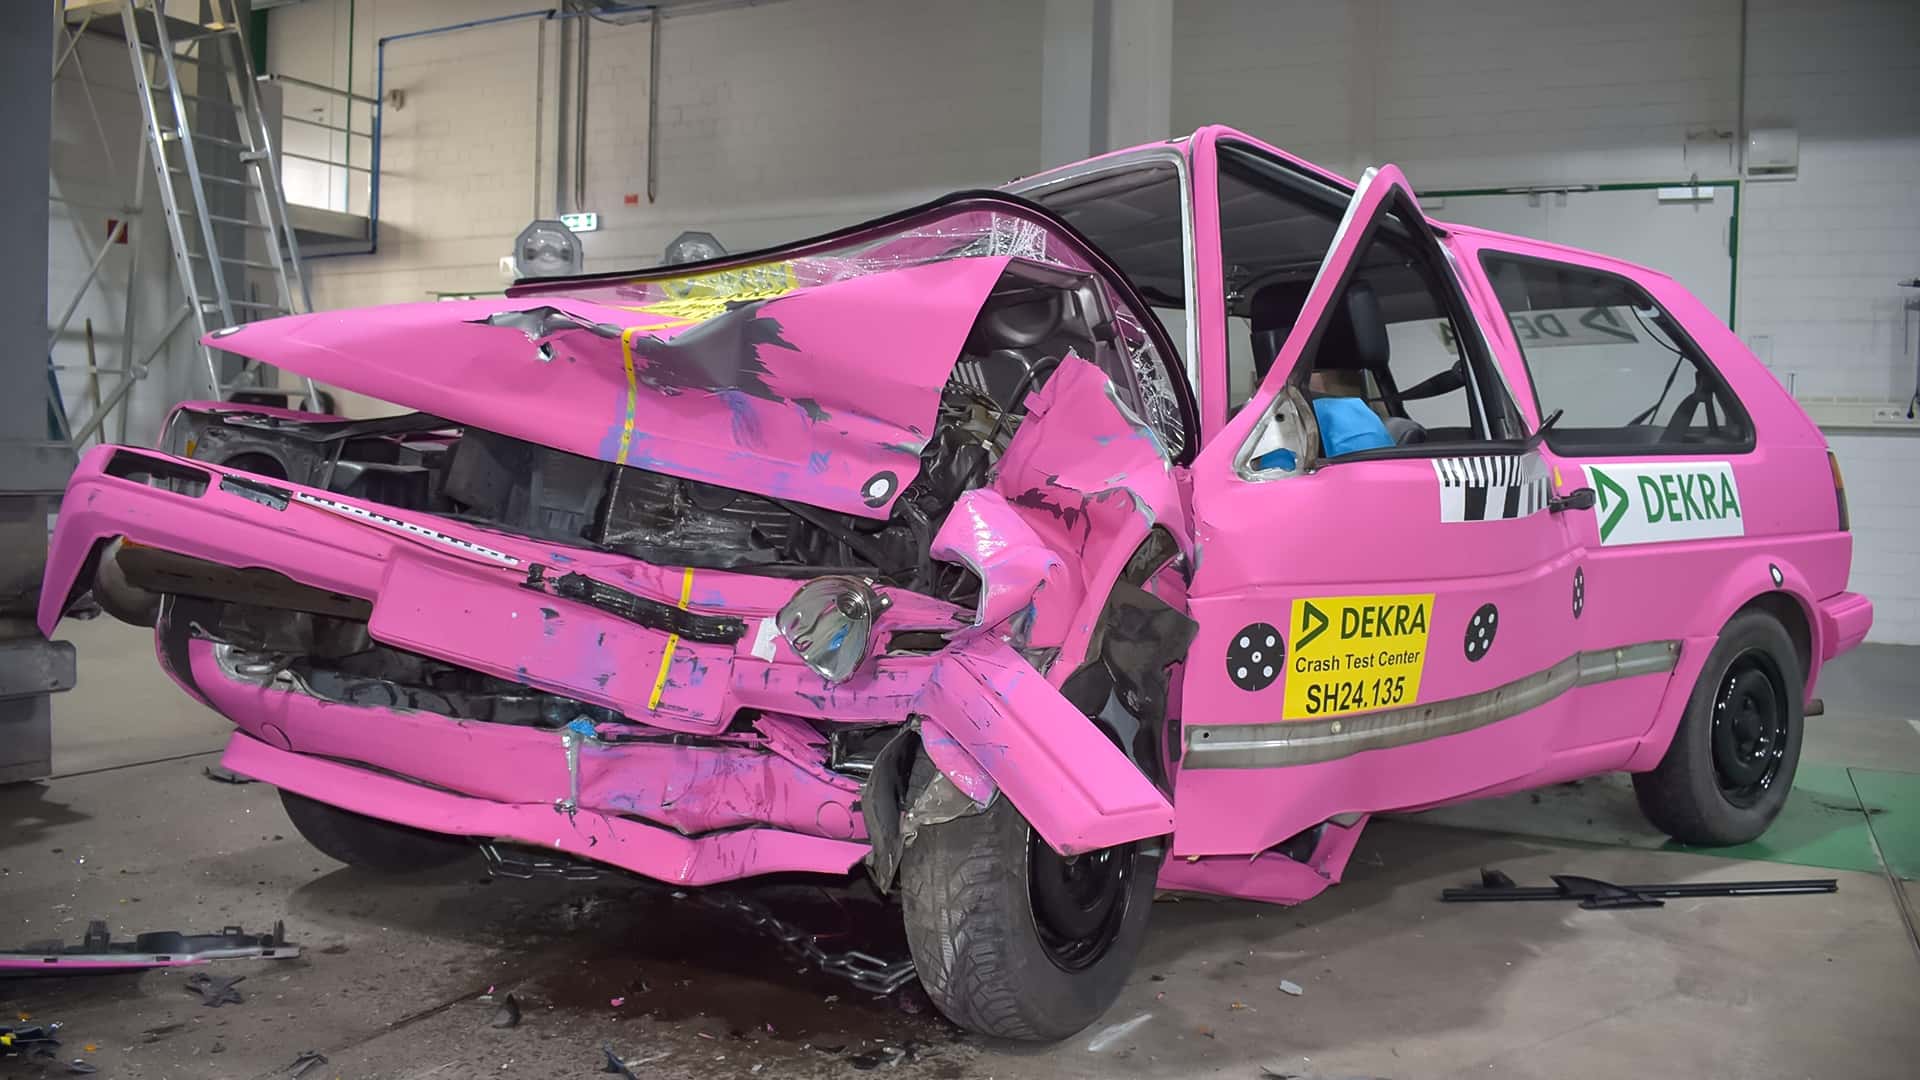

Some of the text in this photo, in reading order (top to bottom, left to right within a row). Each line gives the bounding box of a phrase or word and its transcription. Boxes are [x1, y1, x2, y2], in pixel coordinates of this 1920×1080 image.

[1637, 472, 1741, 523] DEKRA
[1341, 603, 1426, 639] DEKRA
[1295, 650, 1420, 673] Crash Test Center
[1305, 676, 1406, 714] SH24.135
